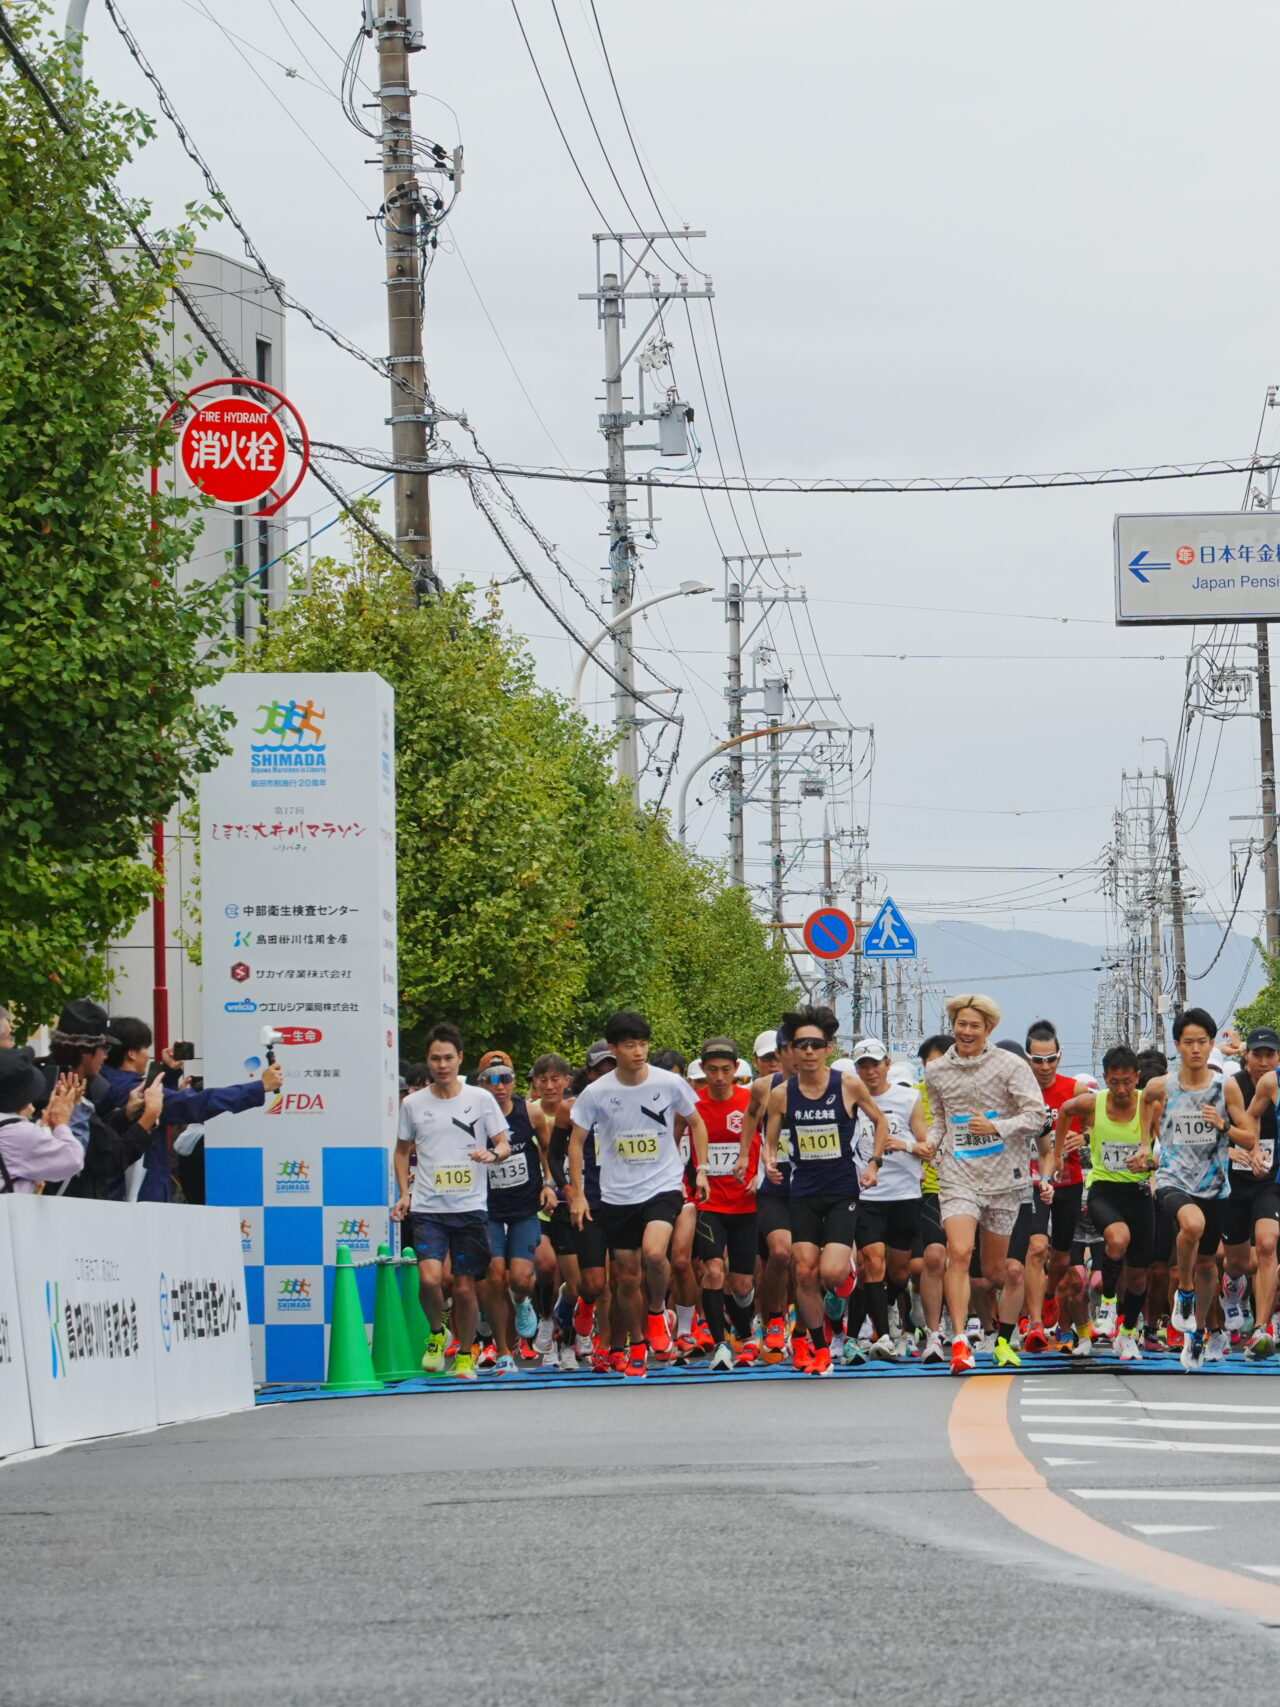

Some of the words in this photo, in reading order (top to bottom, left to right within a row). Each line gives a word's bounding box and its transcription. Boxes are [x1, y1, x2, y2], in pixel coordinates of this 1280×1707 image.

[200, 411, 221, 423] FIRE
[224, 412, 268, 424] HYDRANT
[190, 430, 278, 471] 消火栓
[1192, 576, 1235, 591] Japan
[251, 753, 326, 767] SHIMADA
[243, 905, 359, 917] 中部衛生検査センター
[256, 933, 348, 945] 島田掛川信用金庫
[256, 969, 352, 979] サカイ産業株式会社
[282, 1030, 317, 1042] 一生命
[304, 1069, 341, 1078] 大塚製薬
[285, 1093, 324, 1109] FDA
